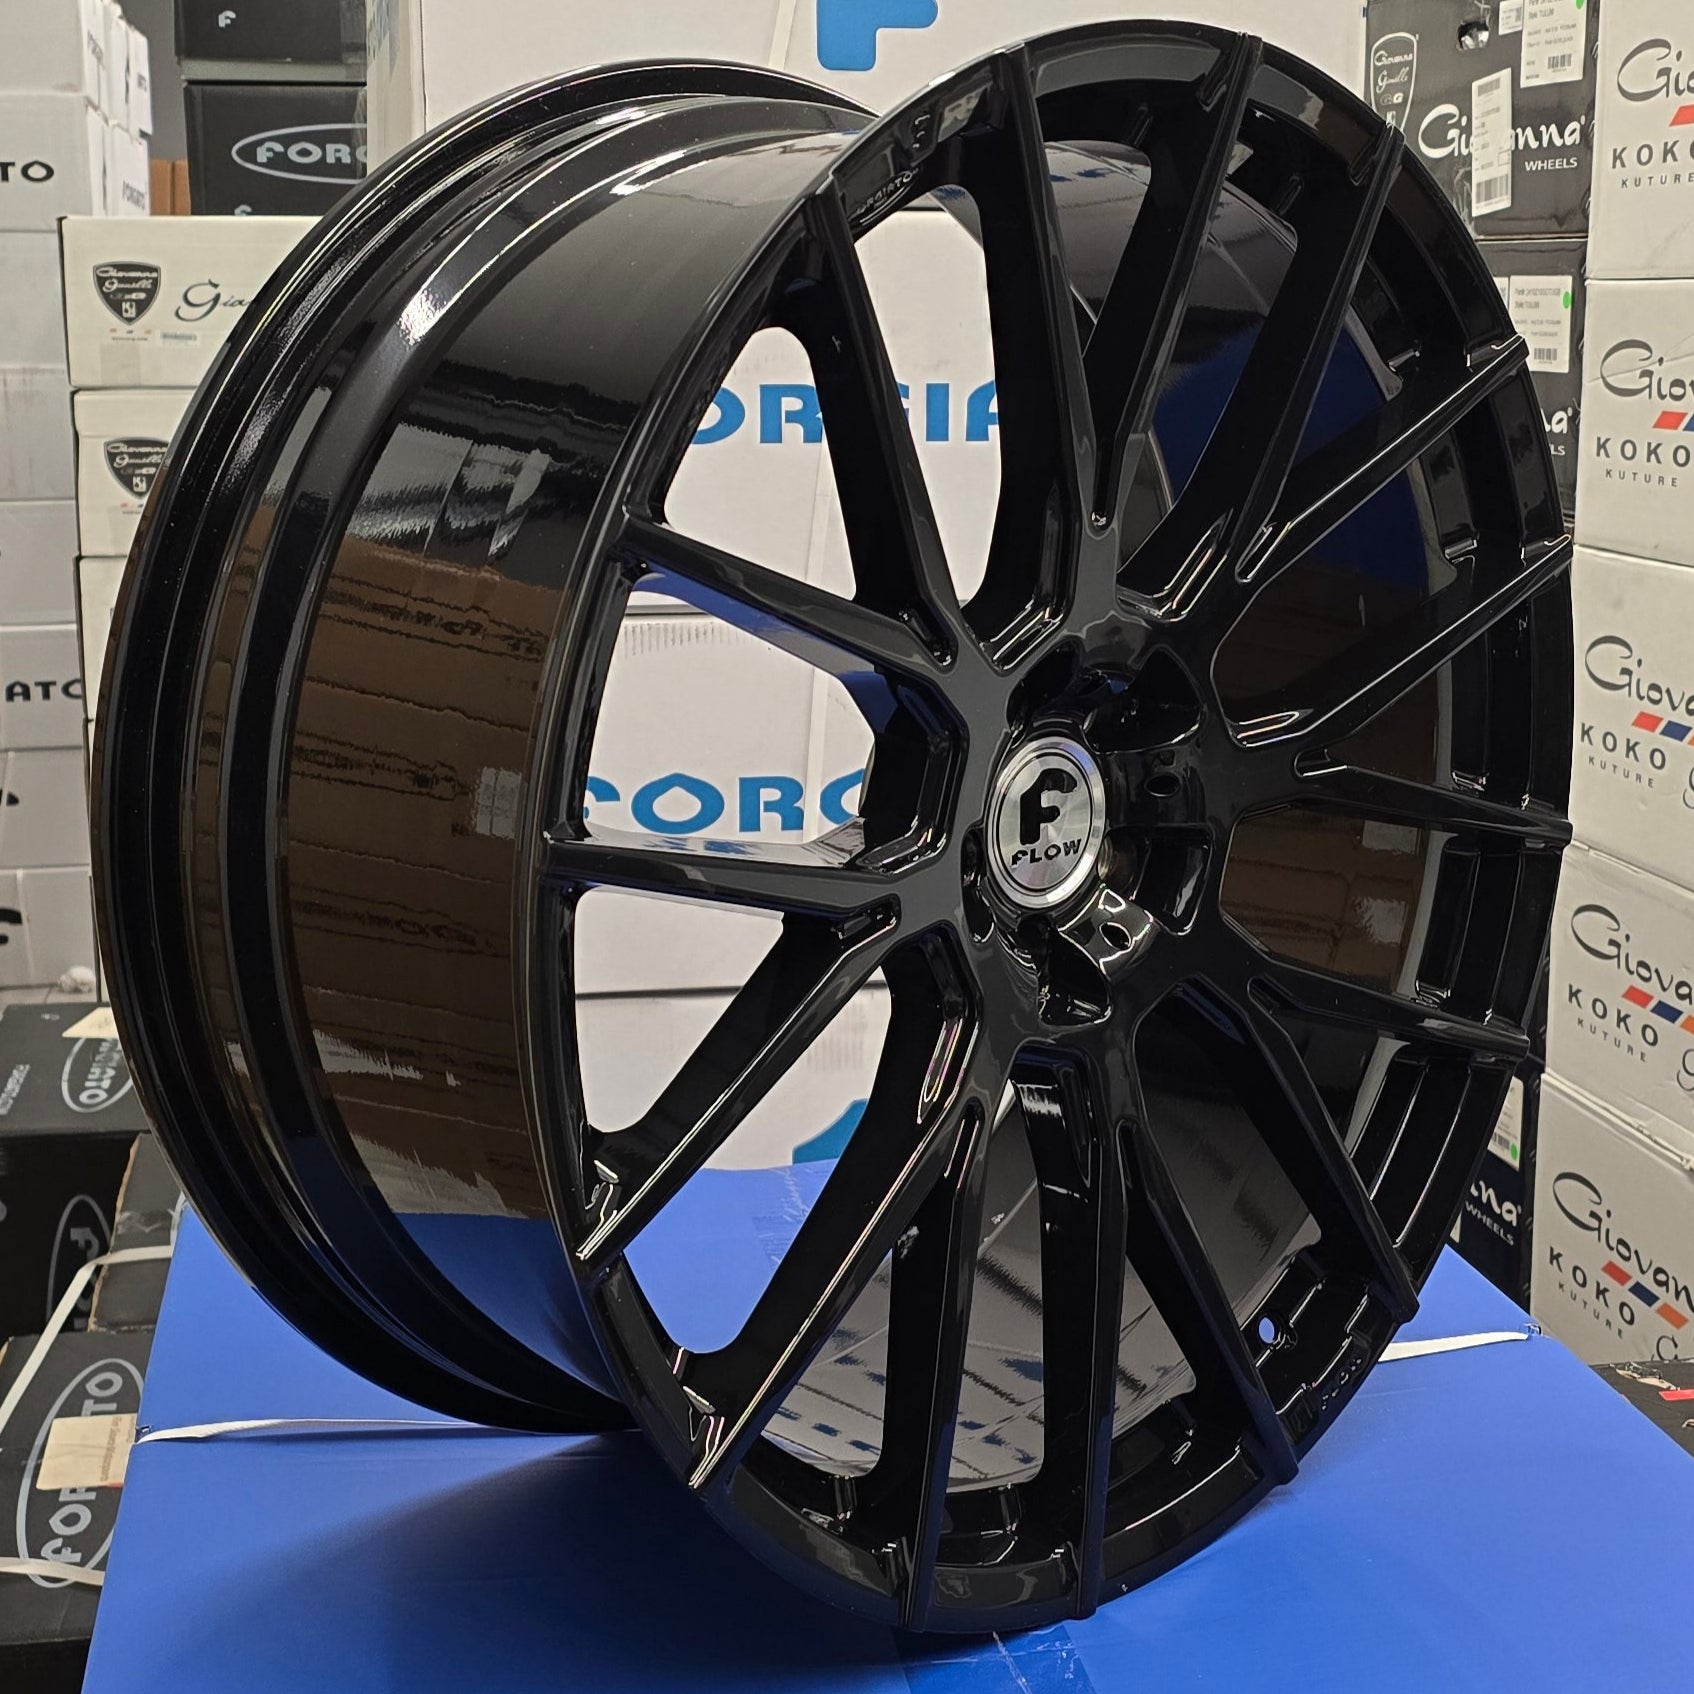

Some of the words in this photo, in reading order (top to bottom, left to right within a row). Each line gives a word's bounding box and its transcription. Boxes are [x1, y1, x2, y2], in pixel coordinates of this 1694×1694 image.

[218, 10, 236, 28] F
[1418, 103, 1582, 159] Ginna
[1525, 157, 1578, 171] WHEELS
[1611, 140, 1694, 169] KOK
[1595, 436, 1692, 468] KOKO
[1605, 468, 1679, 488] KUTURE
[1580, 722, 1667, 771] KOKO
[1588, 755, 1655, 788] KUTURE
[1019, 768, 1078, 846] F
[1011, 838, 1082, 867] FLOW
[1568, 984, 1659, 1047] KOKO
[1577, 1017, 1647, 1063] KUTURE
[1465, 1200, 1515, 1246] WHEELS
[1549, 1246, 1635, 1326] KOKO
[1558, 1281, 1624, 1340] KUTURE
[41, 1371, 124, 1564] FORTO
